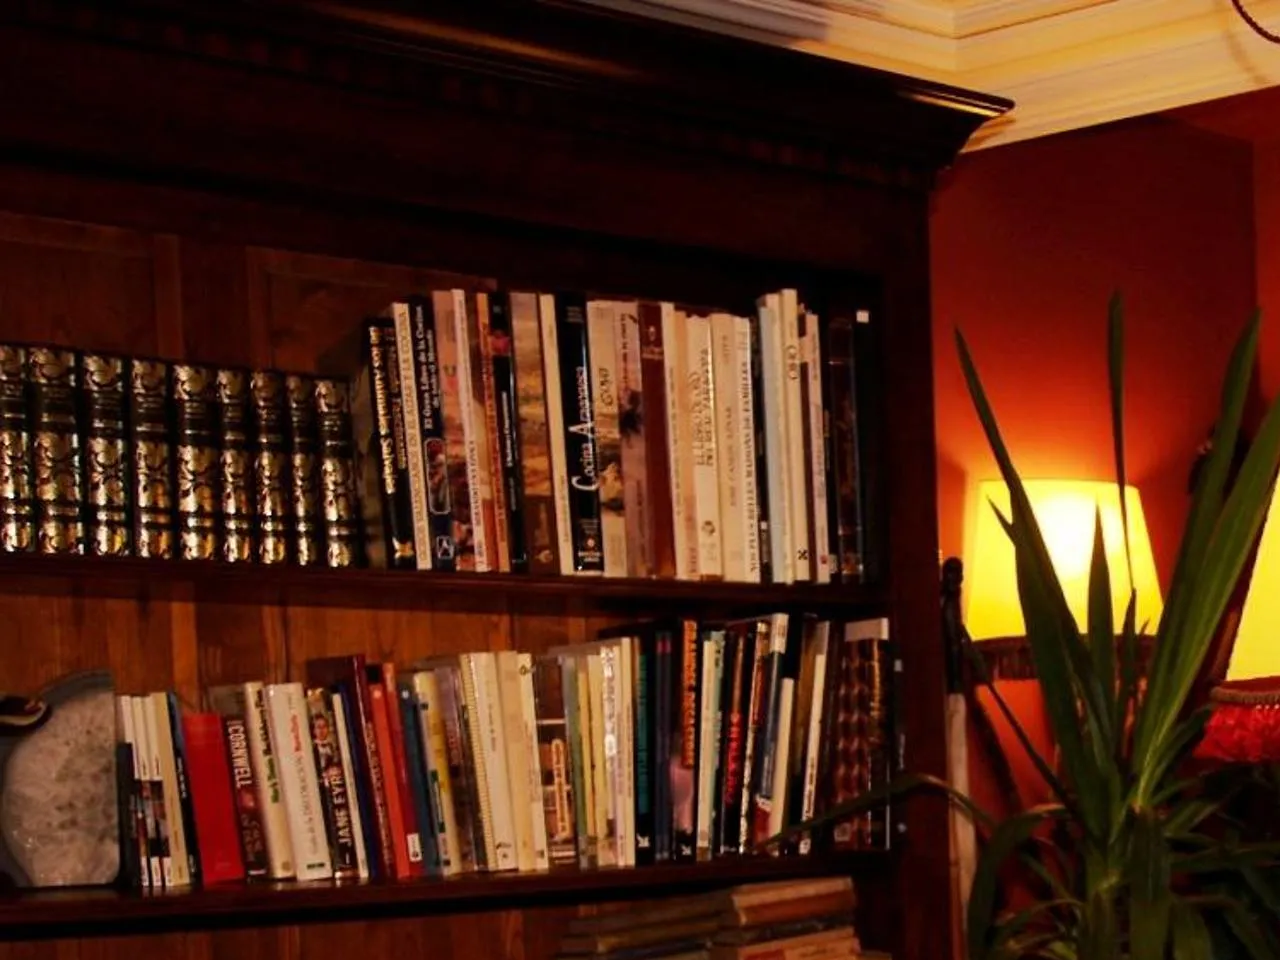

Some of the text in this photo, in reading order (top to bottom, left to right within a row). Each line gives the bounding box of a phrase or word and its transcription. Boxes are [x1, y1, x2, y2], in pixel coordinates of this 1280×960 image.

[374, 369, 391, 436] Animales
[567, 366, 600, 491] Cocina Aragonesa
[380, 437, 398, 495] Salvajes
[228, 725, 252, 789] CORNWELL
[334, 807, 353, 847] JANE
